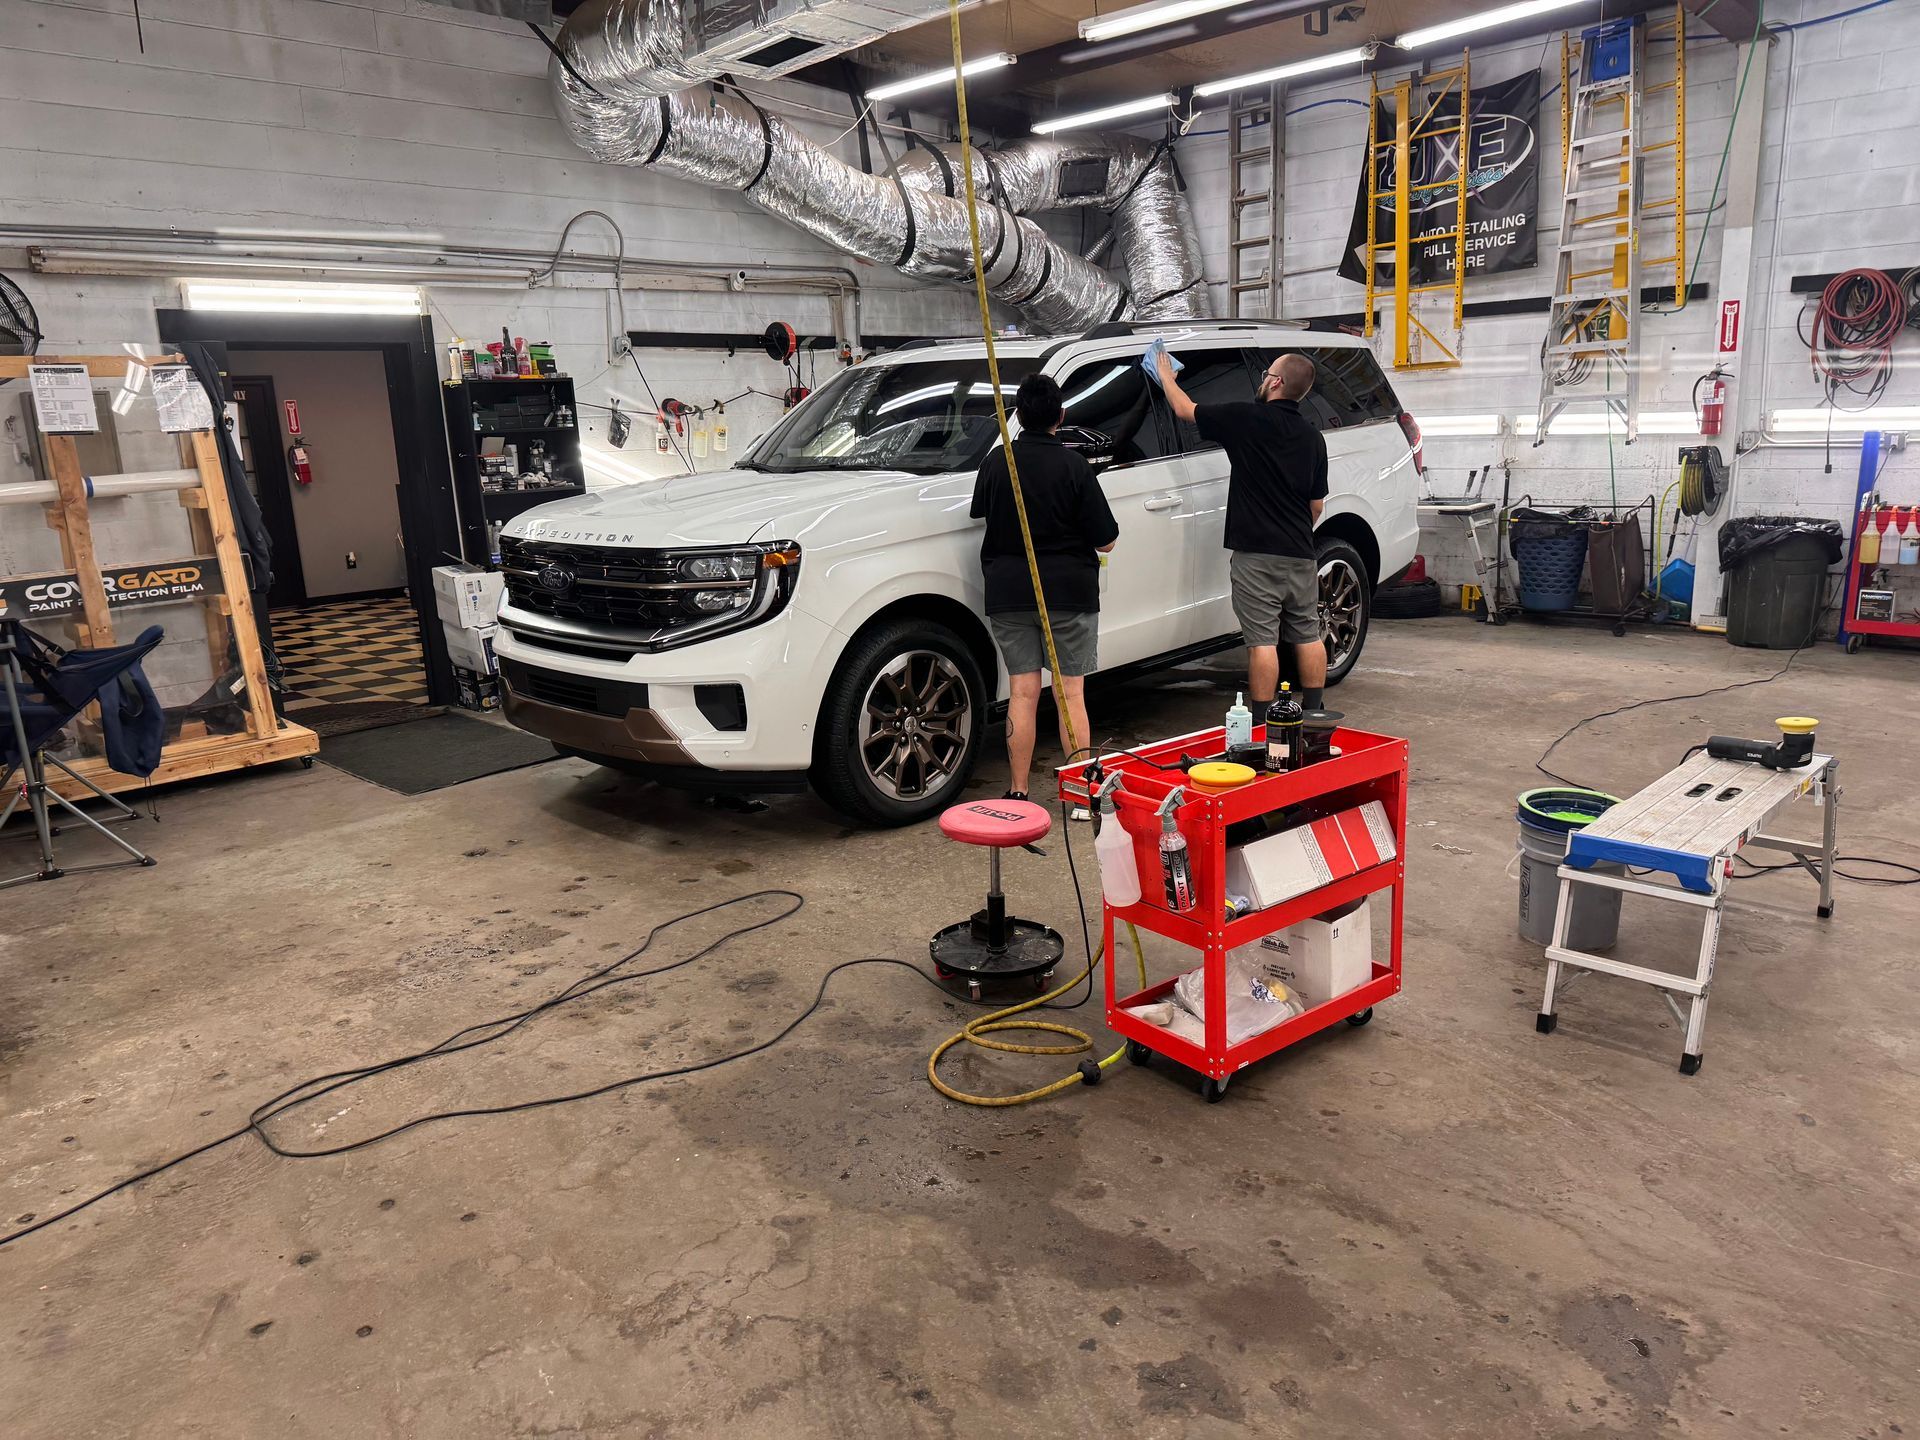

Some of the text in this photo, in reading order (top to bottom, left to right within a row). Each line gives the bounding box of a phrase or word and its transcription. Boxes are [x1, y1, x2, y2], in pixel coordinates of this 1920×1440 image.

[1423, 231, 1516, 259] FULL ERVICE
[1446, 254, 1485, 271] HRE
[514, 525, 635, 543] EXPEDITION
[25, 566, 201, 601] COVRGARD
[29, 600, 73, 613] PAINT
[172, 583, 204, 595] FILM
[1173, 853, 1187, 908] PAINT PREP
